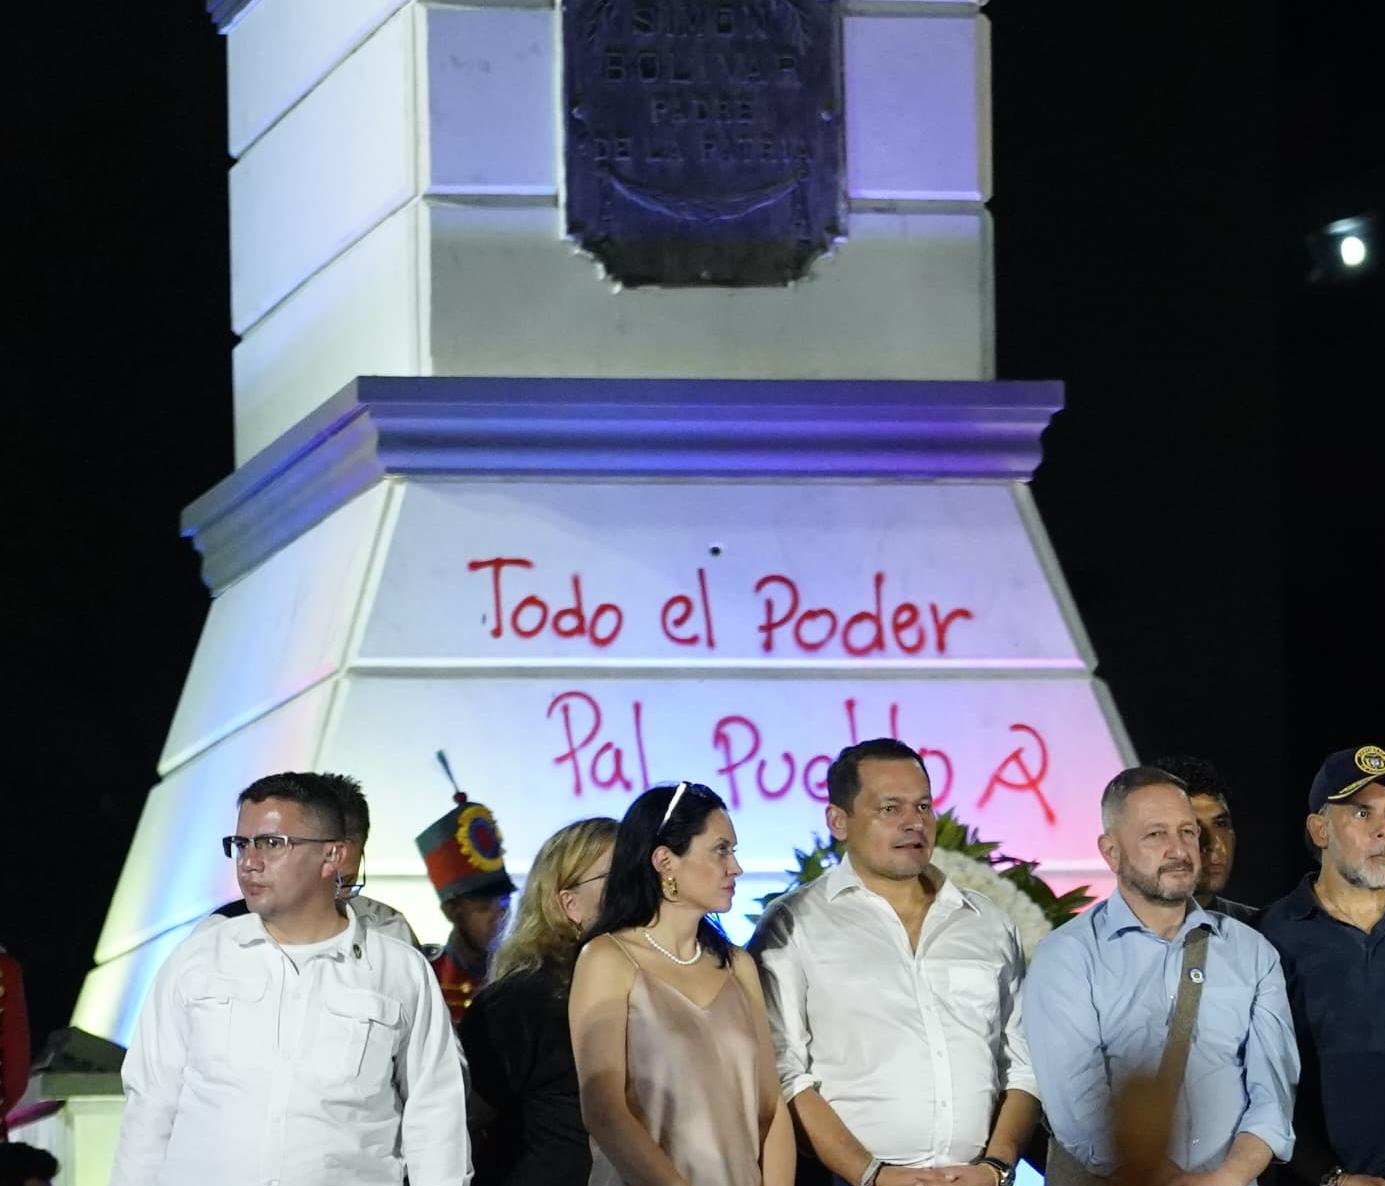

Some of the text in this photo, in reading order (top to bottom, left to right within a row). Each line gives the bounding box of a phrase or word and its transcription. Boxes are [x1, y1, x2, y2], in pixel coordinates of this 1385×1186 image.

[467, 556, 975, 657] Todo el Poder
[547, 690, 650, 798] Pal
